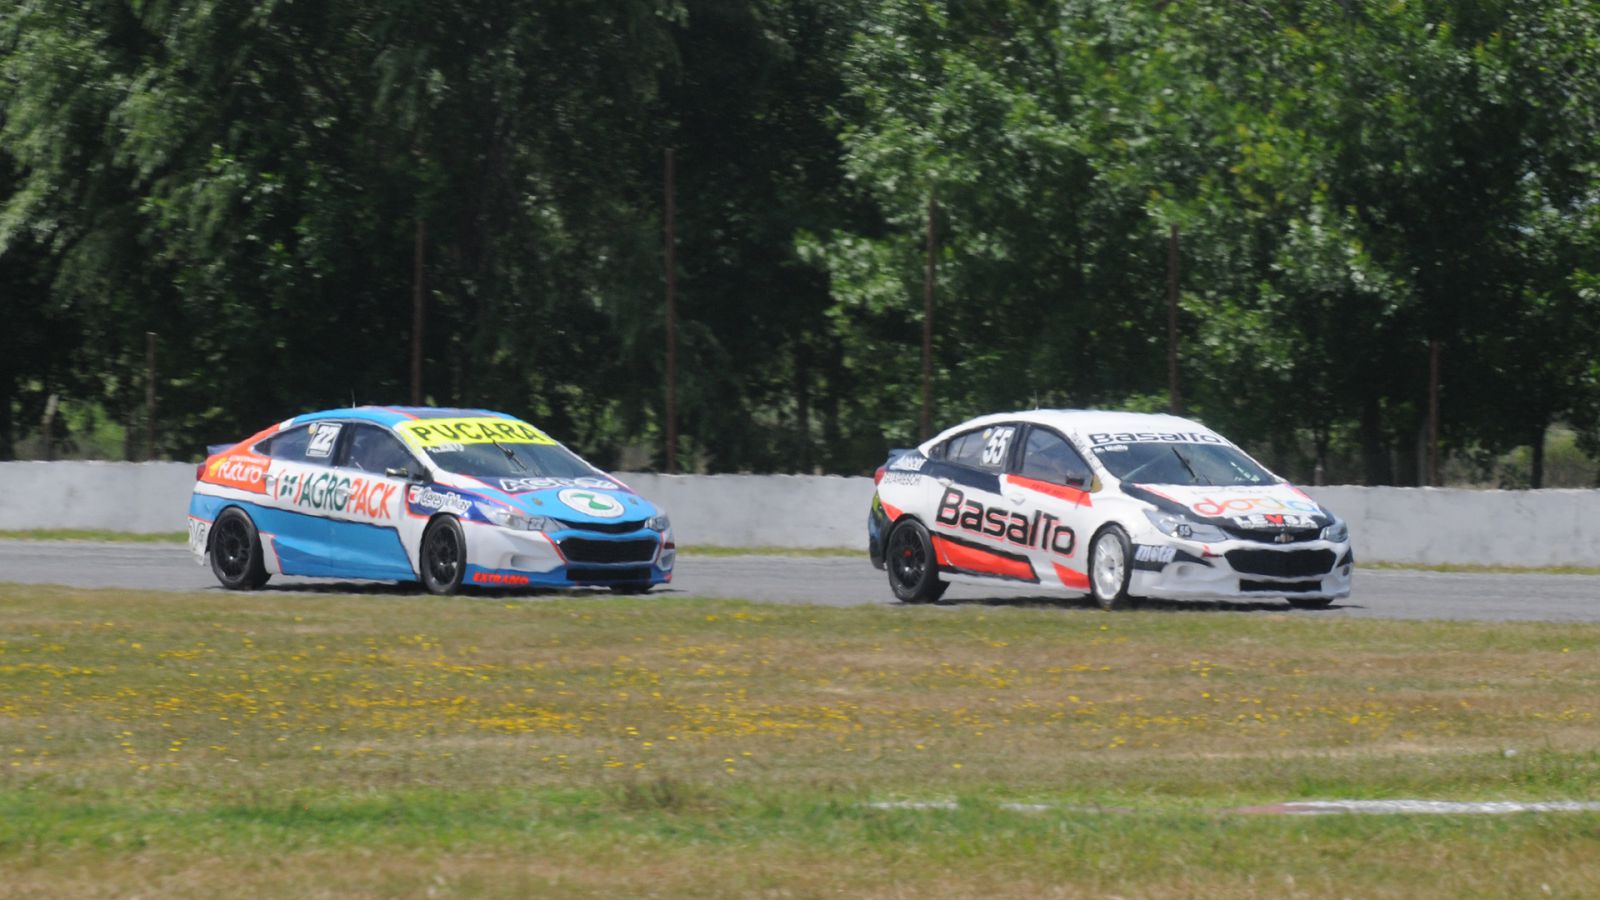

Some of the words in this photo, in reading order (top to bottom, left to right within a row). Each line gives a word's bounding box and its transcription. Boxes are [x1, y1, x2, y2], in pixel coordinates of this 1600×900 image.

[310, 425, 341, 451] 22
[410, 421, 546, 442] PUCARA
[981, 427, 1016, 464] 55
[299, 472, 397, 519] AGROPACK
